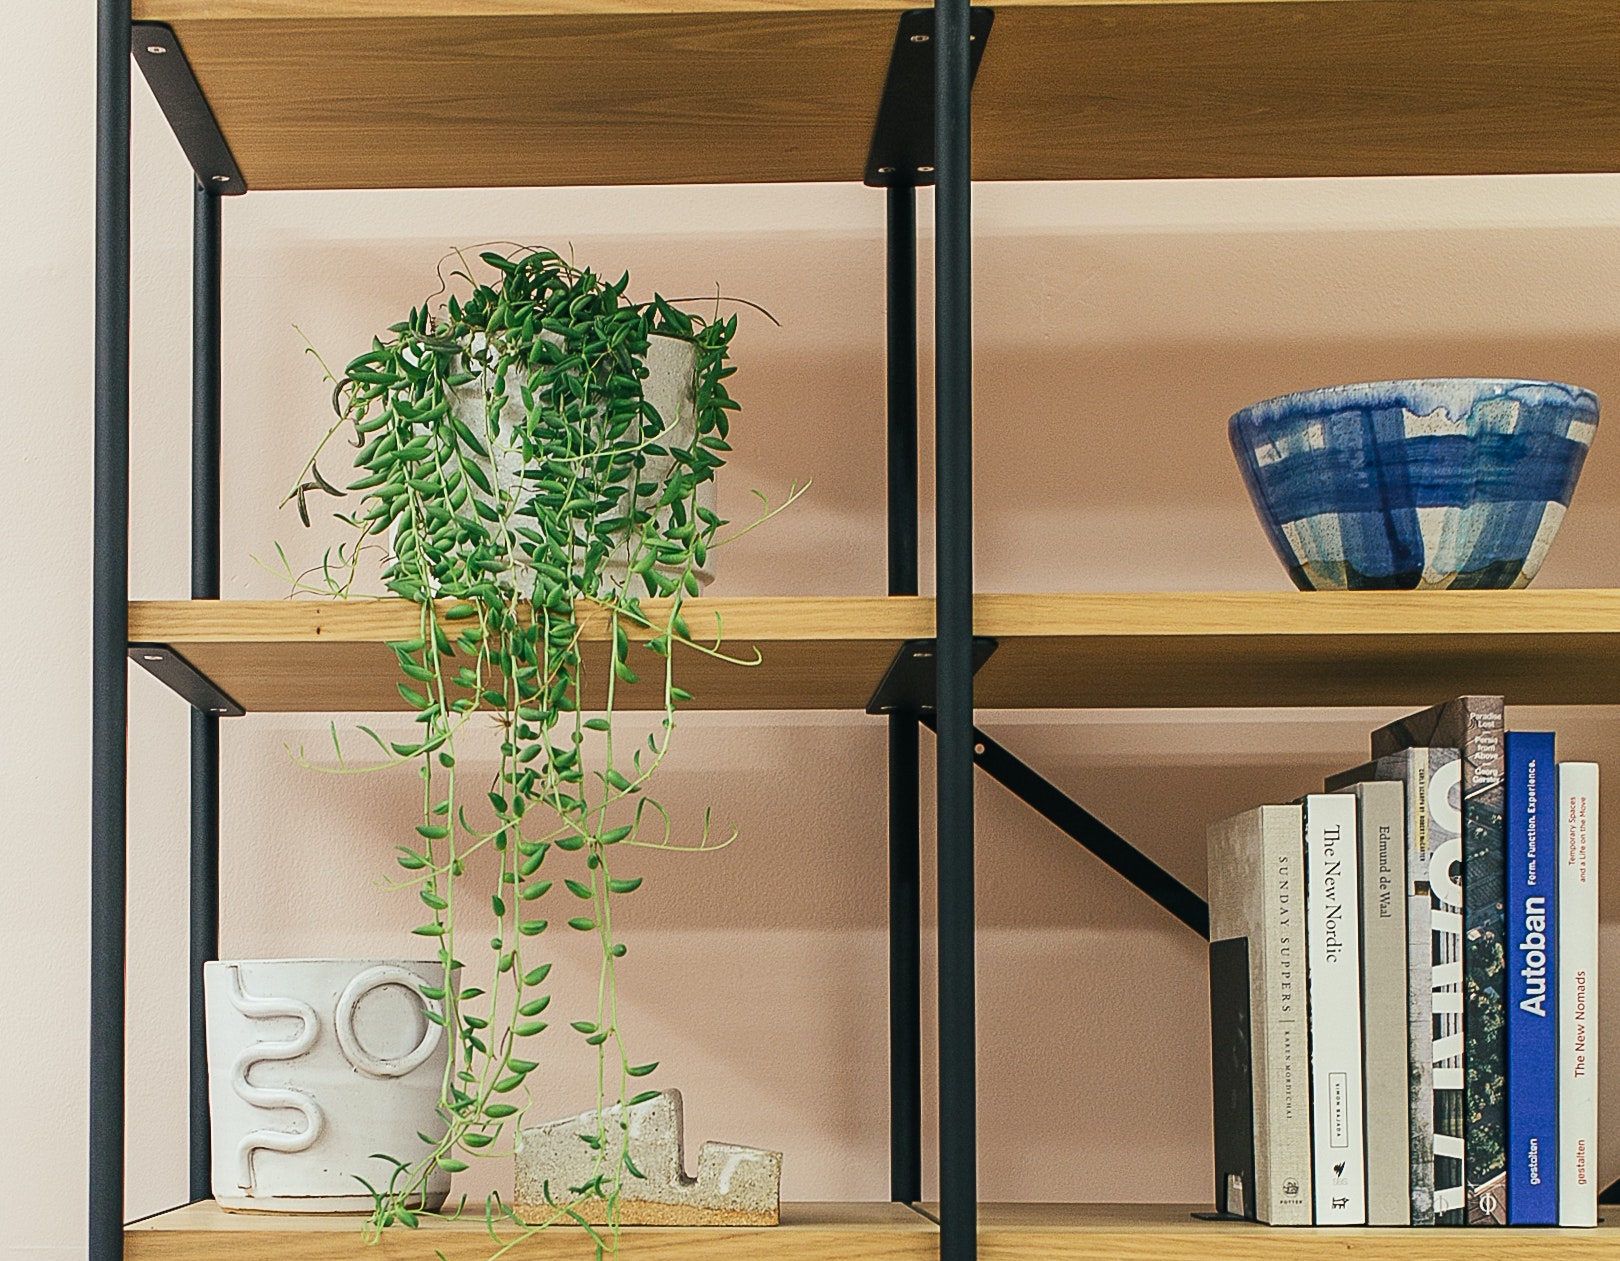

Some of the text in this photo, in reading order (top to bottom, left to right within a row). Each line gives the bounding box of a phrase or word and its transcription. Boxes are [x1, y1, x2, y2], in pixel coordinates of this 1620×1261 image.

[1470, 712, 1502, 720] Paradise
[1474, 736, 1498, 745] Persia
[1477, 744, 1496, 752] from
[1474, 752, 1499, 760] Above
[1474, 767, 1499, 776] Georg
[1578, 796, 1587, 818] Move
[1526, 759, 1538, 886] Form. Function. Experience.
[1568, 796, 1579, 866] Temporary Spaces
[1578, 818, 1587, 833] the
[1579, 834, 1587, 845] on
[1578, 845, 1587, 861] Life
[1378, 825, 1392, 919] Edmund de Waal
[1578, 868, 1587, 883] and
[1323, 824, 1343, 962] The New Nordic
[1278, 856, 1292, 1014] SUNDAY SUPPERS
[1520, 896, 1546, 1017] Autoban
[1574, 970, 1586, 1078] The New Nomads
[1528, 1138, 1540, 1186] gestalten
[1576, 1139, 1587, 1186] gestalten
